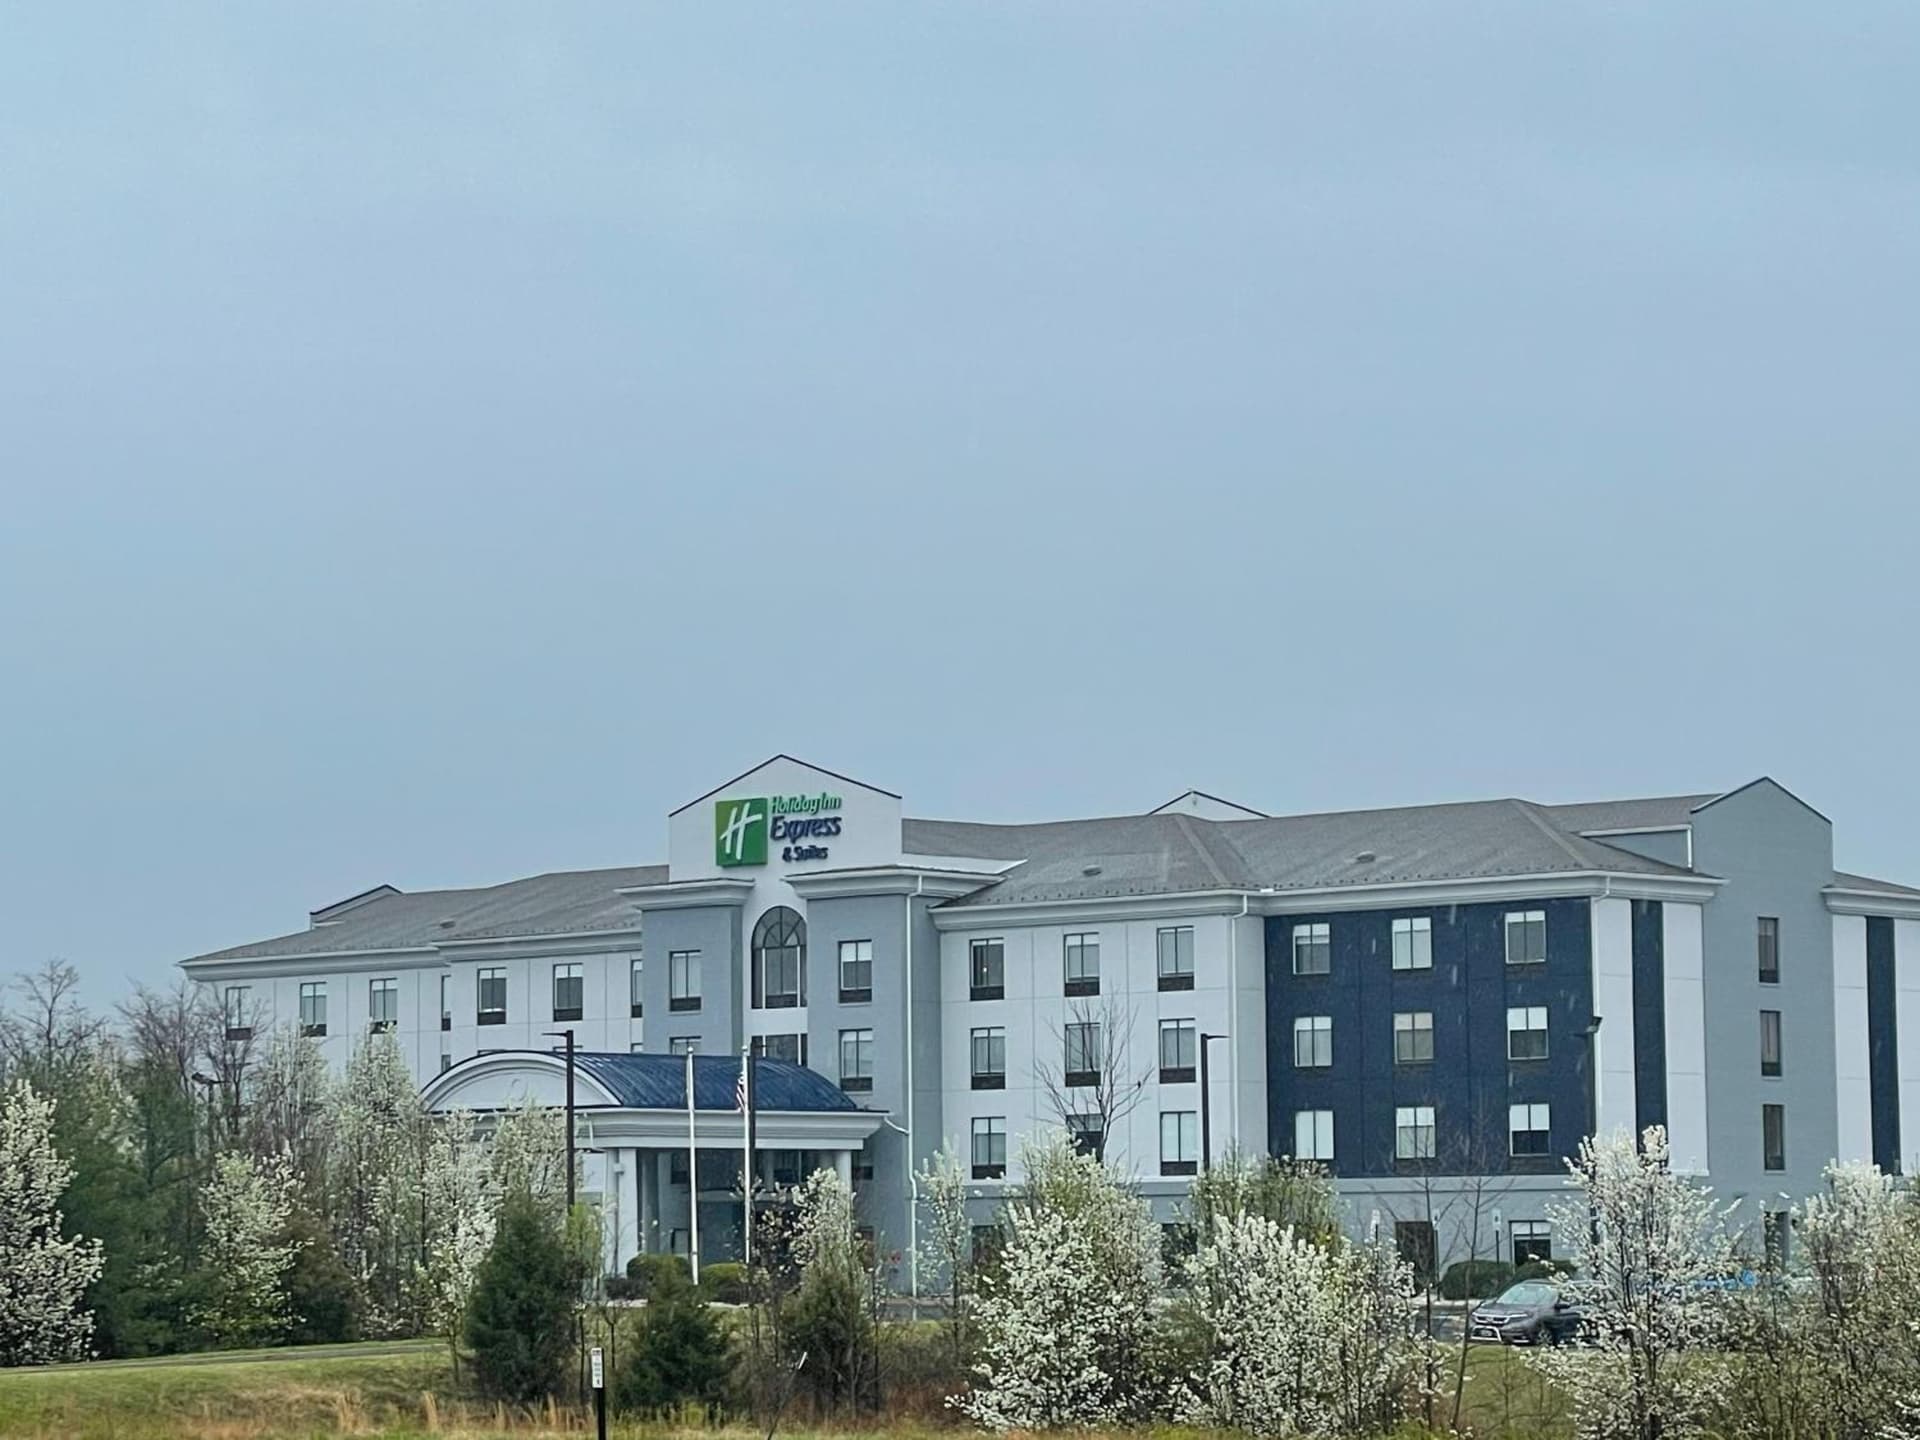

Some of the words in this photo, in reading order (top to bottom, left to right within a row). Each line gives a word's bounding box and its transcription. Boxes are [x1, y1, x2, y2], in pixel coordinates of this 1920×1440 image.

[771, 796, 819, 815] Holiday
[820, 792, 842, 810] Inn
[770, 815, 842, 844] Express
[782, 847, 792, 862] &
[793, 845, 829, 861] Suites
